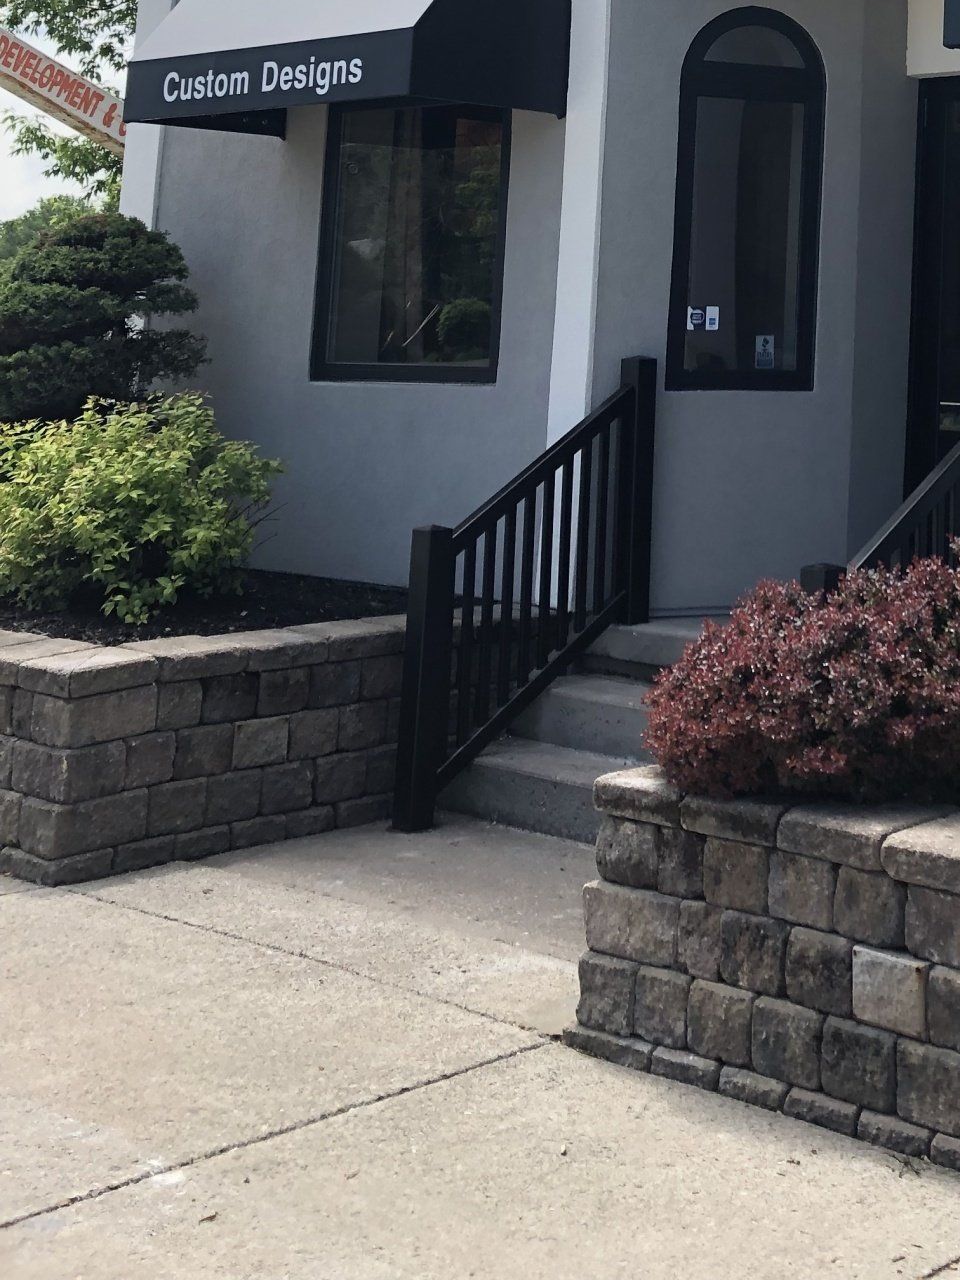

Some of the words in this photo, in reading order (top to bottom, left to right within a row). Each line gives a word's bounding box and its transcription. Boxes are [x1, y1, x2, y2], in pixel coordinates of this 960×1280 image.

[0, 34, 105, 118] DEVELOPMENT
[102, 102, 118, 128] &
[163, 70, 249, 103] Custom
[261, 56, 363, 96] Designs
